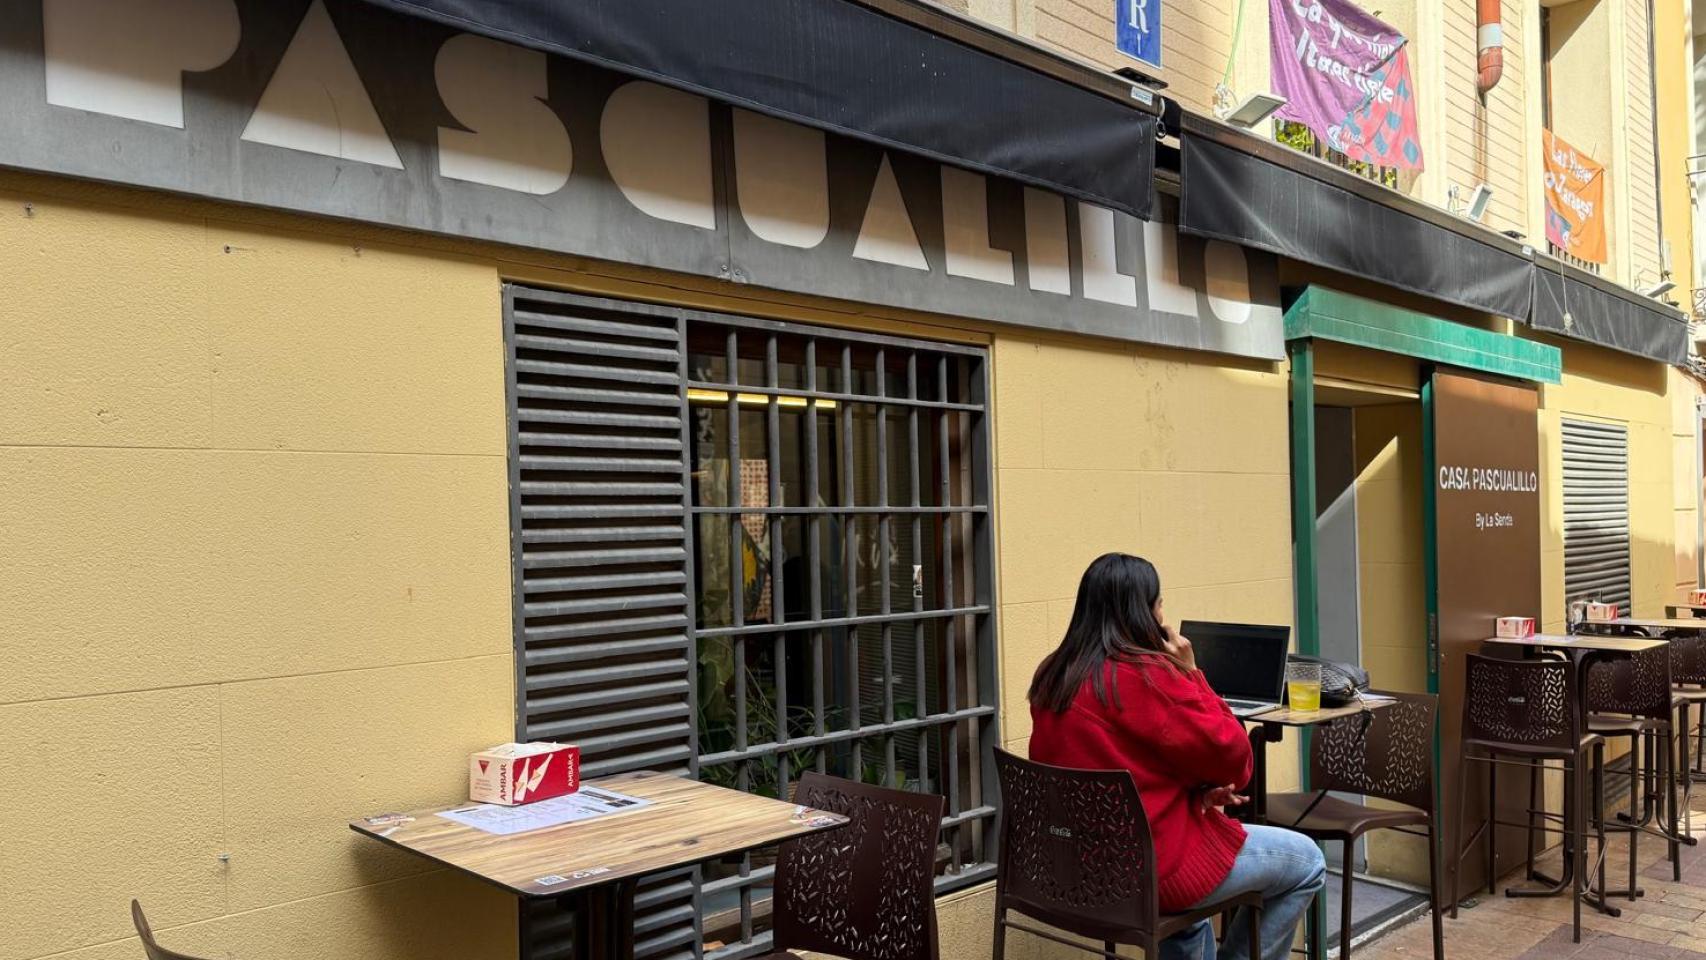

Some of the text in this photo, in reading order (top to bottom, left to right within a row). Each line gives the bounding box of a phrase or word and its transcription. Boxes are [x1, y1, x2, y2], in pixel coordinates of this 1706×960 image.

[1439, 466, 1537, 492] CASA PASCUALILLO
[1475, 512, 1485, 531] By
[1485, 513, 1494, 527] La
[499, 763, 507, 801] AMBAR
